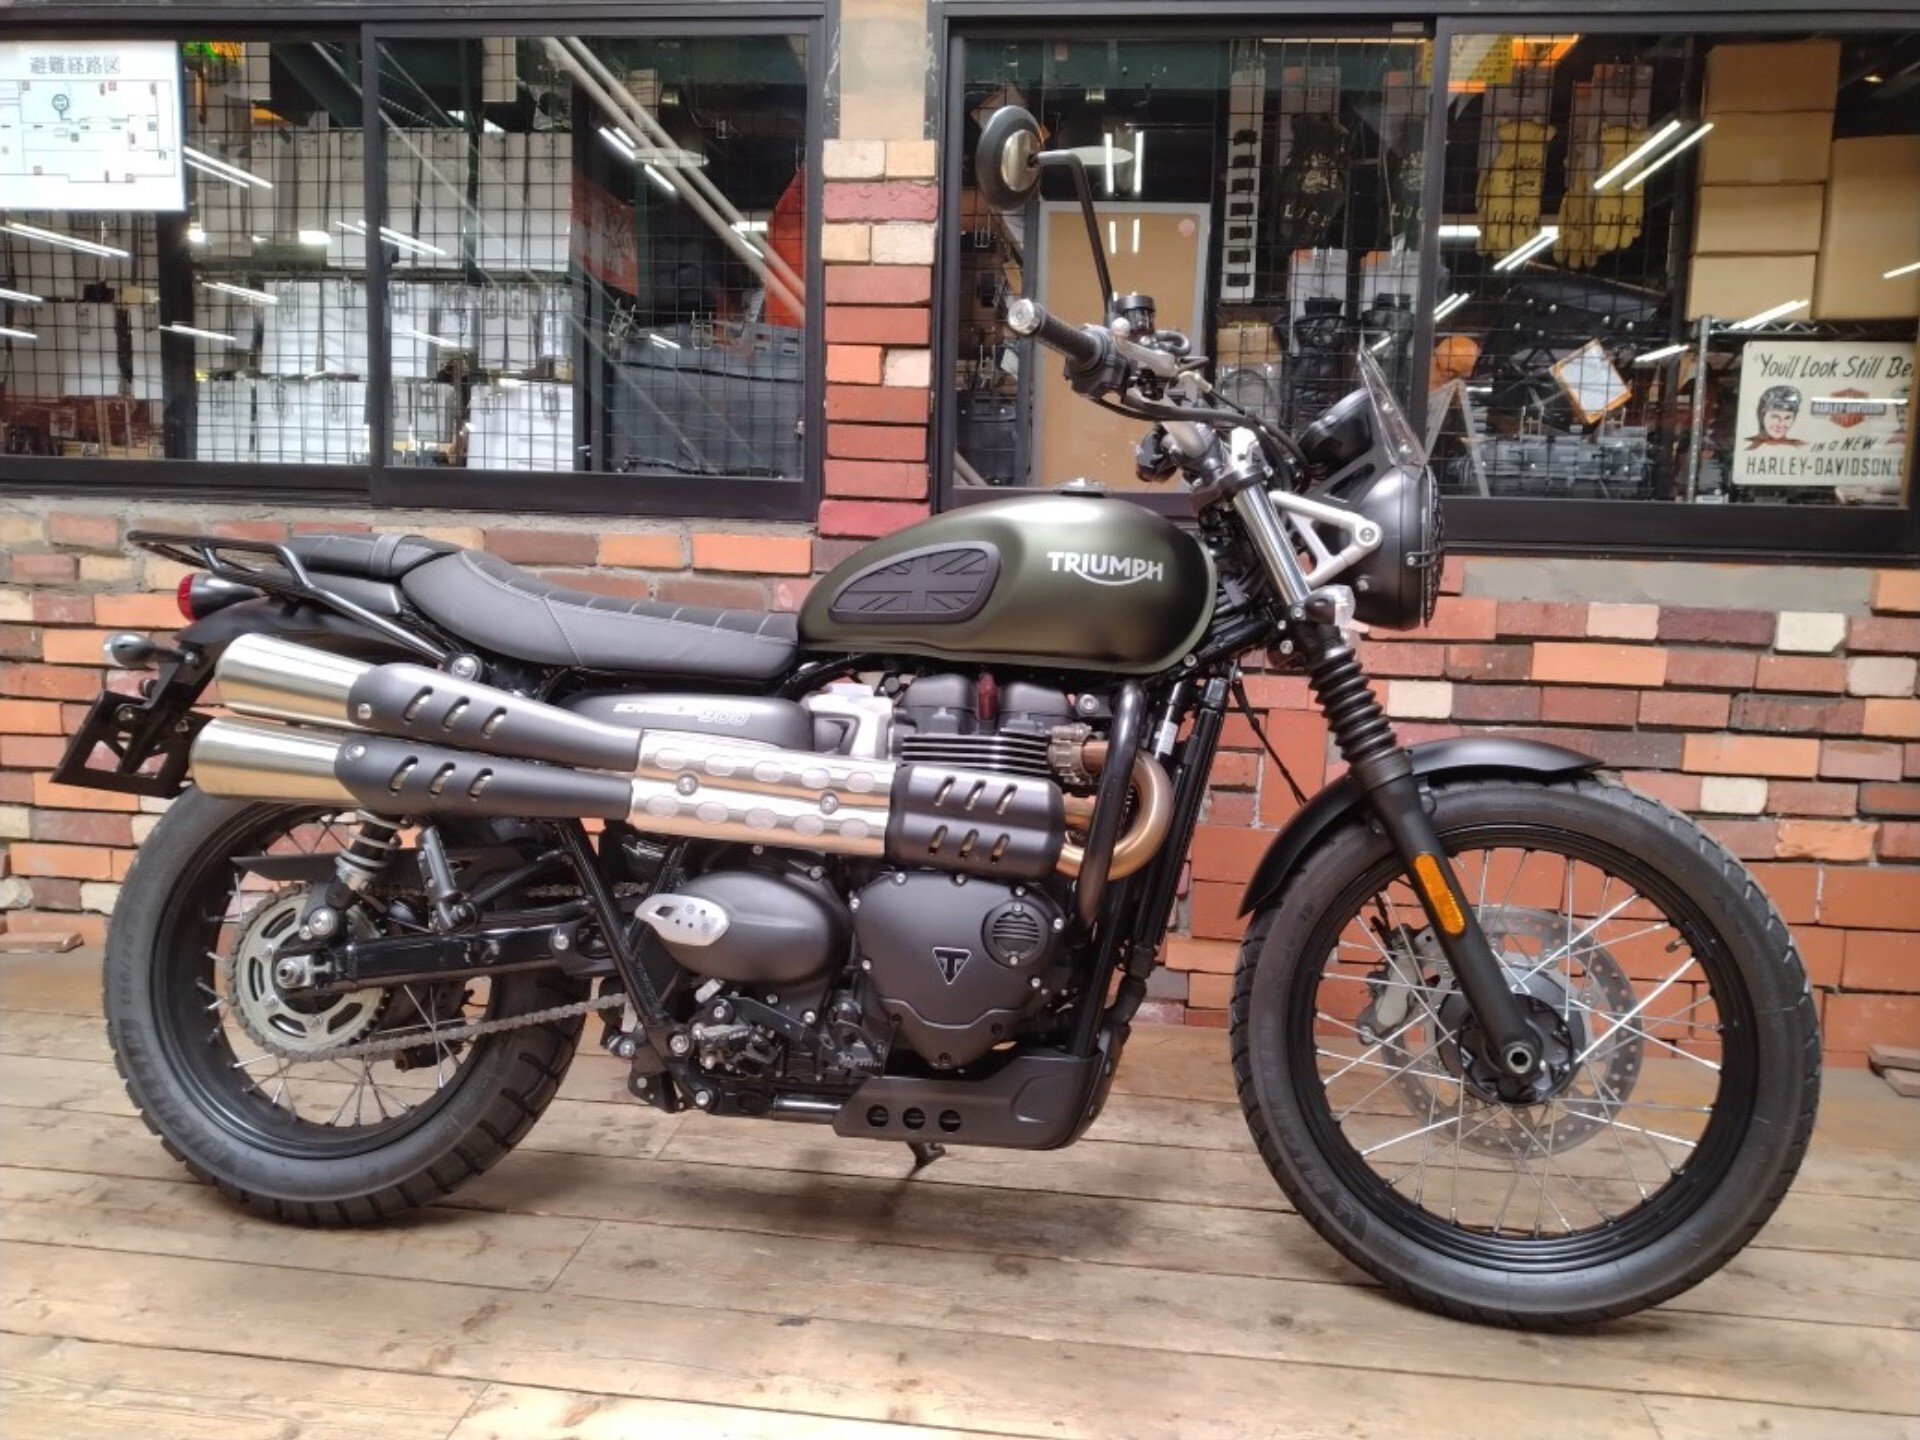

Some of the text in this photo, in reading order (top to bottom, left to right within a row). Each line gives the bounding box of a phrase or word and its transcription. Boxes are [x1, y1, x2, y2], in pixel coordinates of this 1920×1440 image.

[1800, 354, 1839, 377] Look
[1842, 355, 1885, 379] Still
[1885, 356, 1914, 379] Be
[1840, 436, 1878, 451] NEW
[1047, 552, 1163, 585] TRIUMPH
